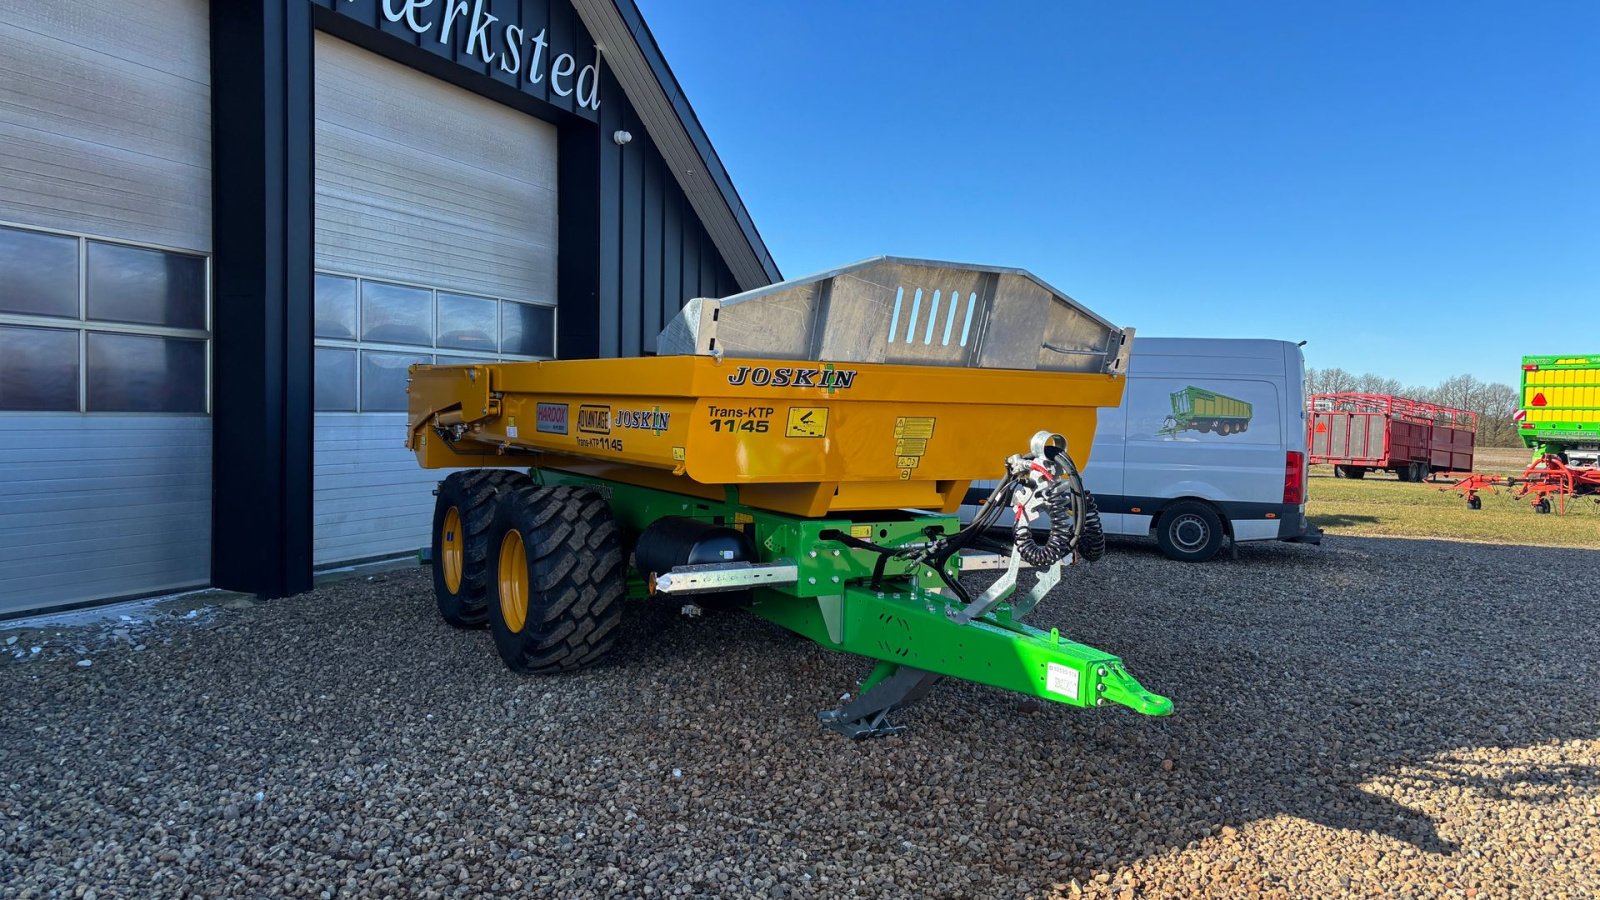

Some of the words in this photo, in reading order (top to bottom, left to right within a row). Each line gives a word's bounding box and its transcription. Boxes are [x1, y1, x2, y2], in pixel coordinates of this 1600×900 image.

[339, 0, 601, 111] ærksted
[728, 366, 858, 389] JOSKIN
[537, 406, 567, 423] HARDOX
[576, 409, 609, 431] ADVANTAGE
[615, 409, 670, 430] JOSKIN
[708, 406, 774, 418] Trans-KTP
[576, 436, 600, 448] Trans-KTP
